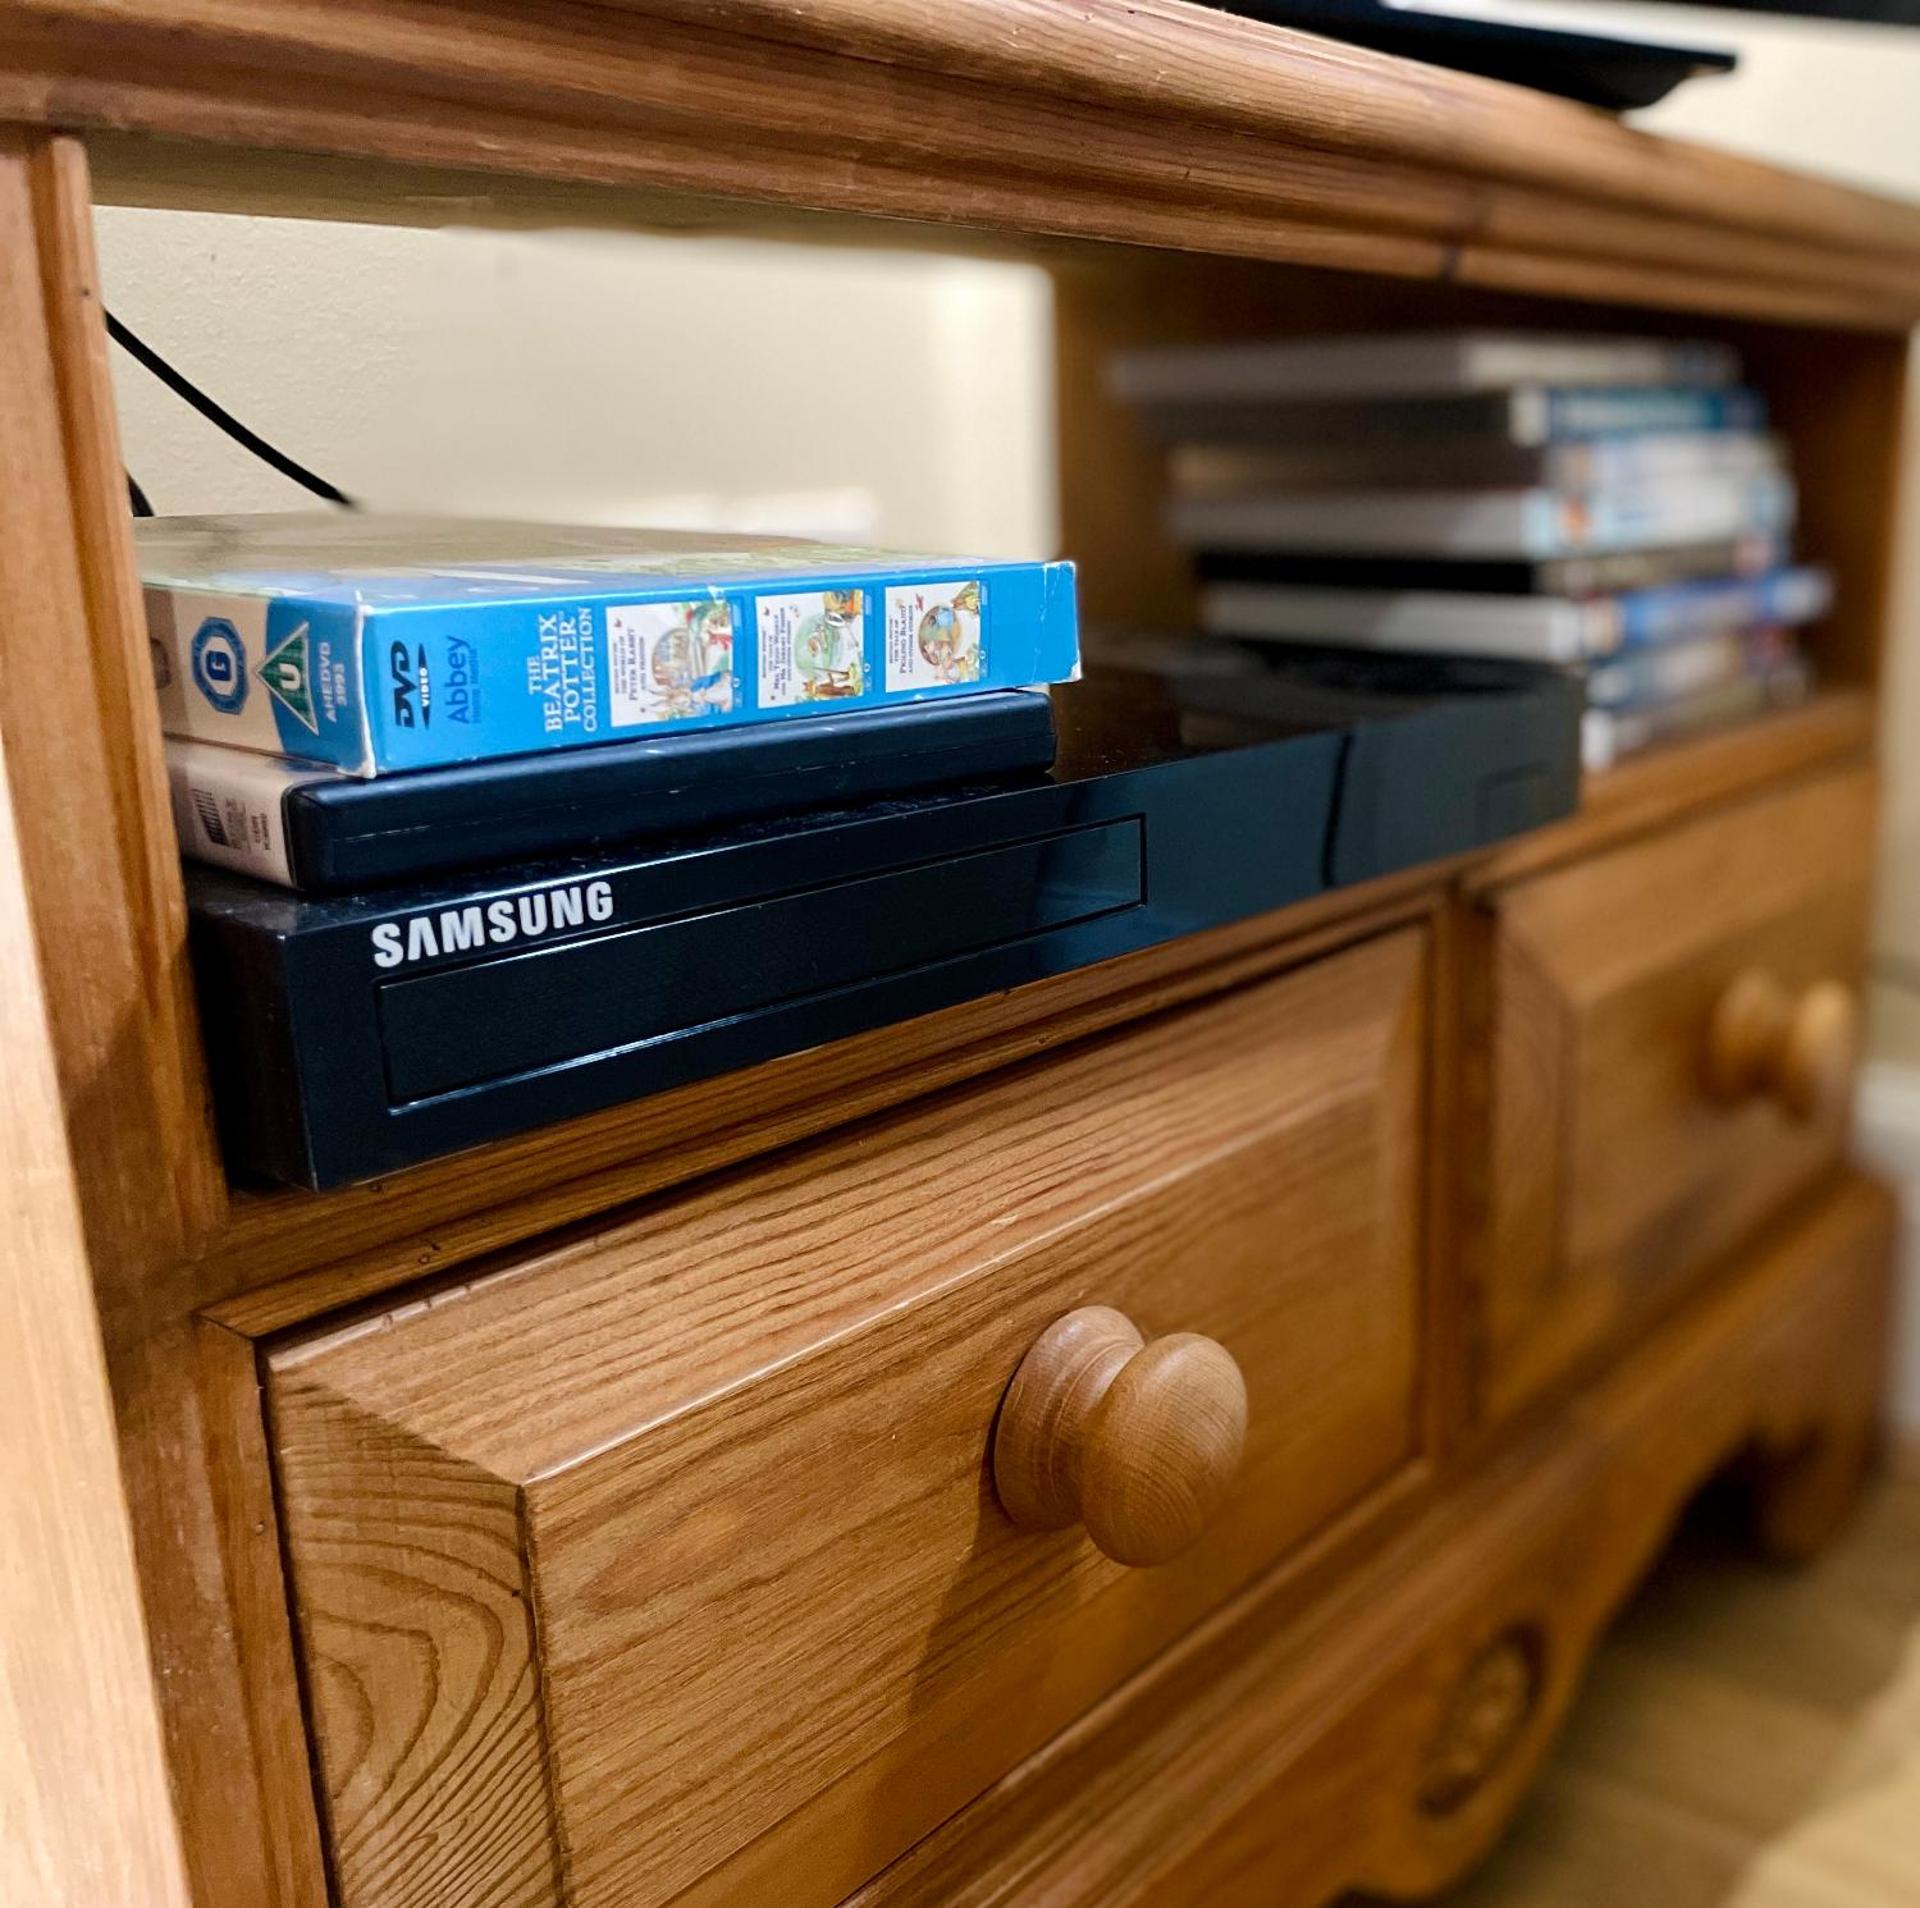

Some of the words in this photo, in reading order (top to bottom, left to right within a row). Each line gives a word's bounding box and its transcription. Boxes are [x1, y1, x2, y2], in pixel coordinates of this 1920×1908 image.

[279, 663, 300, 690] U
[390, 640, 418, 729] DVD
[419, 667, 431, 707] VIDEO
[443, 635, 471, 724] Abbey
[527, 655, 542, 695] THE
[538, 613, 563, 733] BEATRIX
[559, 616, 581, 722] POTTER
[578, 606, 598, 732] COLLECTION
[627, 668, 638, 701] PETER
[371, 881, 614, 968] SAMSUNG
